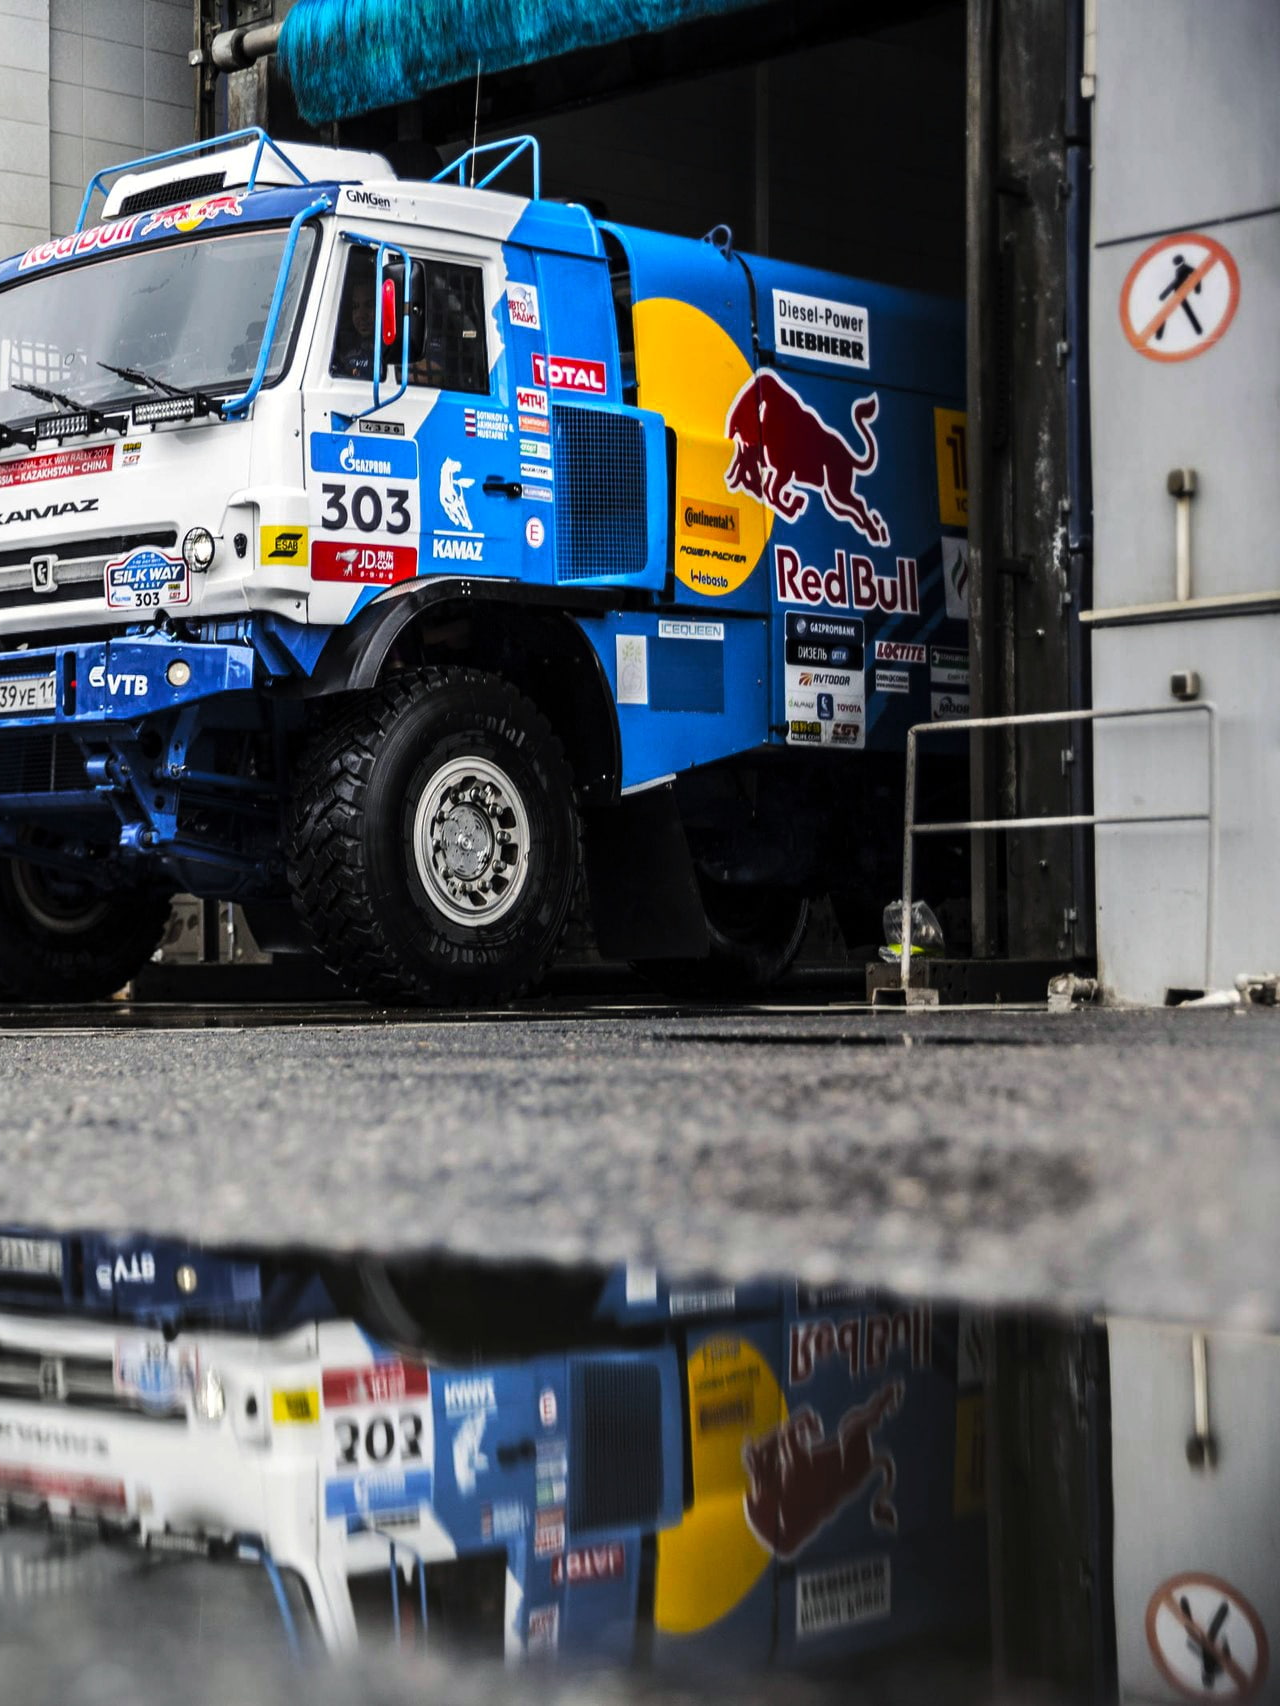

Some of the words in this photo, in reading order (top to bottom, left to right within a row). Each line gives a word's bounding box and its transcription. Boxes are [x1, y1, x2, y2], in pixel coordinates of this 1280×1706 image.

[346, 189, 391, 208] GMGen
[779, 299, 864, 332] Diesel-Power
[780, 327, 864, 361] LIEBHERR
[534, 358, 603, 389] TOTAL
[38, 457, 53, 469] SILK
[54, 455, 70, 466] WAY
[70, 451, 92, 463] RALLY
[93, 448, 109, 460] 2017
[354, 460, 391, 475] GAZPROM
[20, 464, 74, 483] KAZAKHSTAN
[81, 459, 108, 475] CHINA
[321, 483, 411, 535] 303
[684, 506, 729, 531] Continental
[529, 524, 540, 541] E
[275, 539, 298, 551] ESAB
[432, 539, 484, 561] KAMAZ
[680, 545, 747, 563] POWER-PACKER
[113, 568, 148, 585] SILK
[149, 565, 181, 581] WAY
[690, 569, 729, 588] Webasto
[775, 545, 849, 607] Red
[850, 554, 920, 614] Bull
[133, 581, 160, 589] RALLY
[135, 592, 160, 607] 303
[661, 623, 722, 636] ICEQUEEN
[809, 622, 855, 636] GAZPROMBANK
[876, 642, 925, 661] LOCTITE
[106, 673, 148, 697] VTB
[813, 673, 851, 687] AVTODOR
[837, 703, 862, 713] TOYOTA
